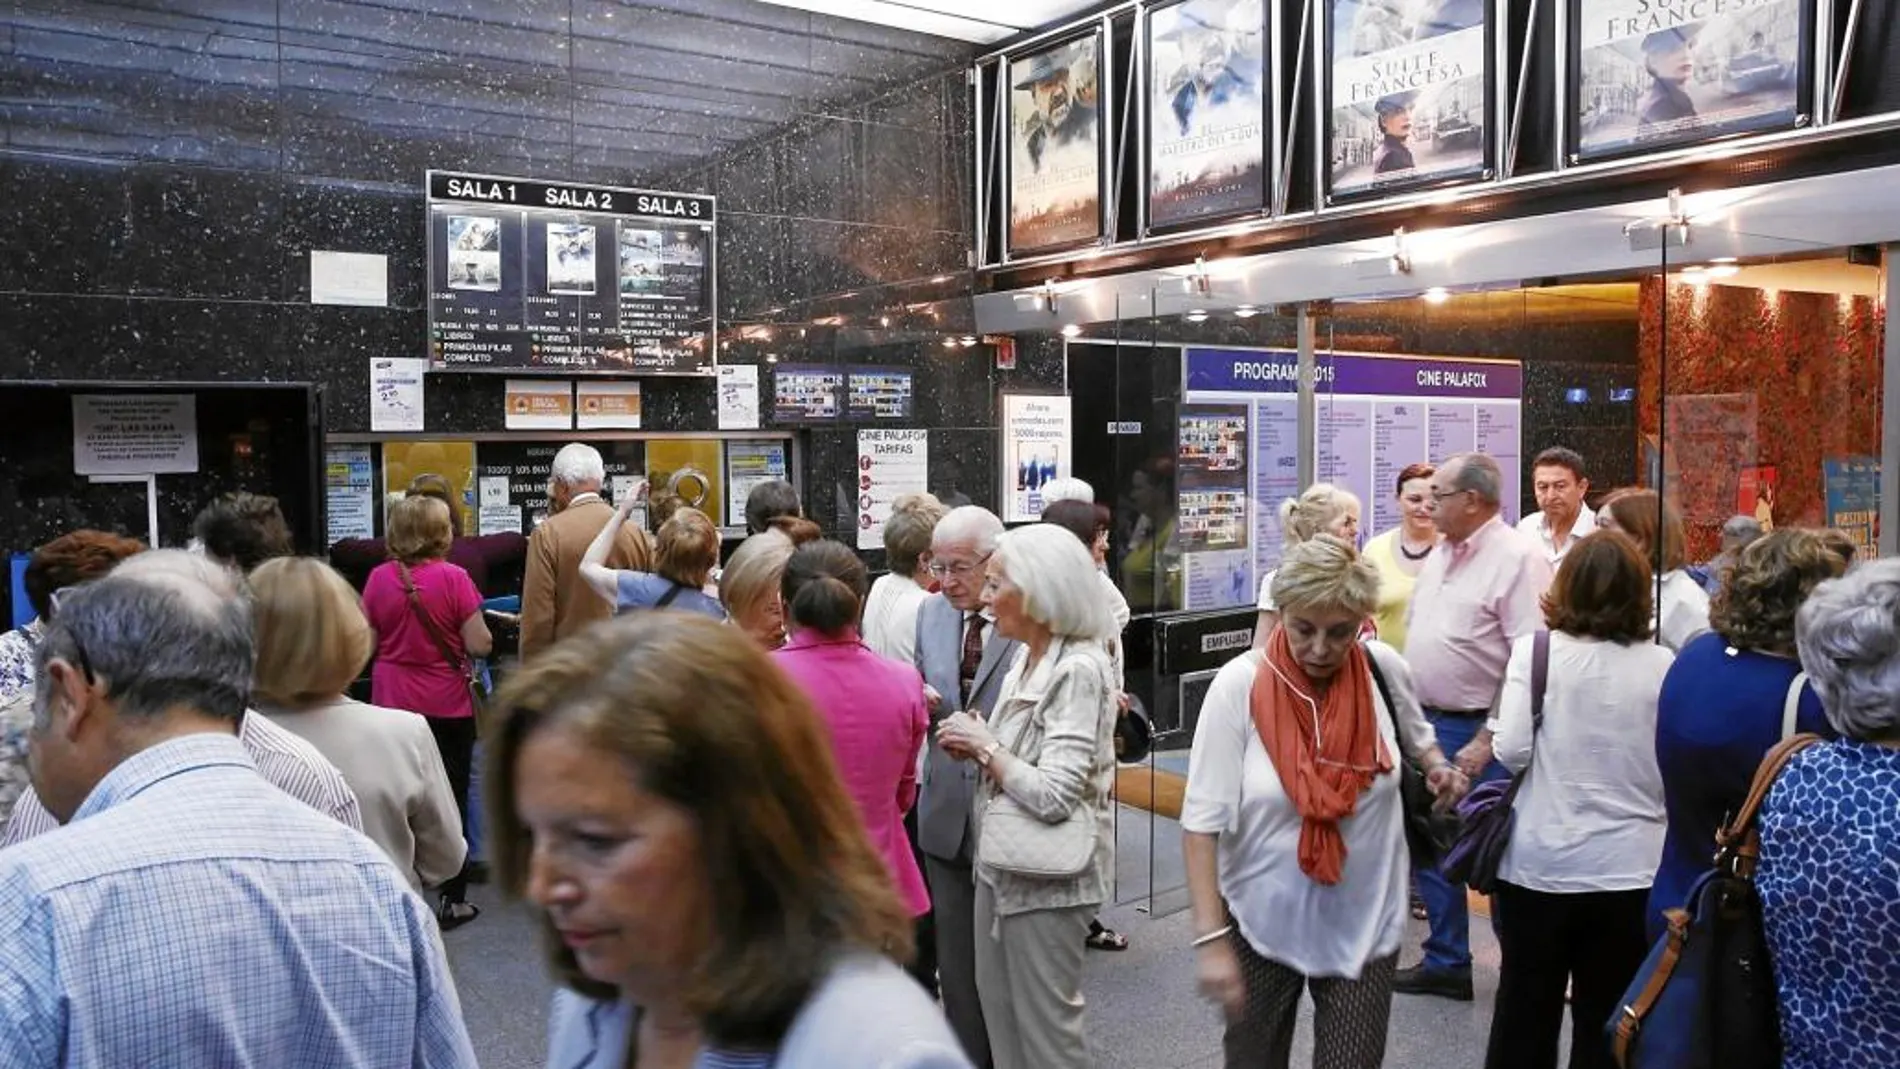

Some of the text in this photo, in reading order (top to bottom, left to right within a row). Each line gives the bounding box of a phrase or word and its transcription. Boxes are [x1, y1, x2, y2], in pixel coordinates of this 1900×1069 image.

[1607, 0, 1769, 39] FRANCES
[1372, 52, 1437, 80] SUITE
[1351, 64, 1463, 101] FRANCESA
[448, 180, 516, 200] SALA 1
[545, 188, 612, 209] SALA 2
[638, 197, 699, 216] SALA 3
[444, 332, 474, 340] LIBRES
[542, 335, 570, 343] LIBRES
[444, 353, 492, 362] COMPLETO
[1234, 362, 1335, 382] PROGRAM 015
[1417, 370, 1487, 387] CINE PALAFOX
[858, 431, 926, 440] CINE PALAFOX
[1109, 423, 1140, 432] PRVADO
[874, 444, 912, 454] TARIFAS
[511, 484, 532, 492] VENTA
[1206, 633, 1249, 649] EMPUJAD
